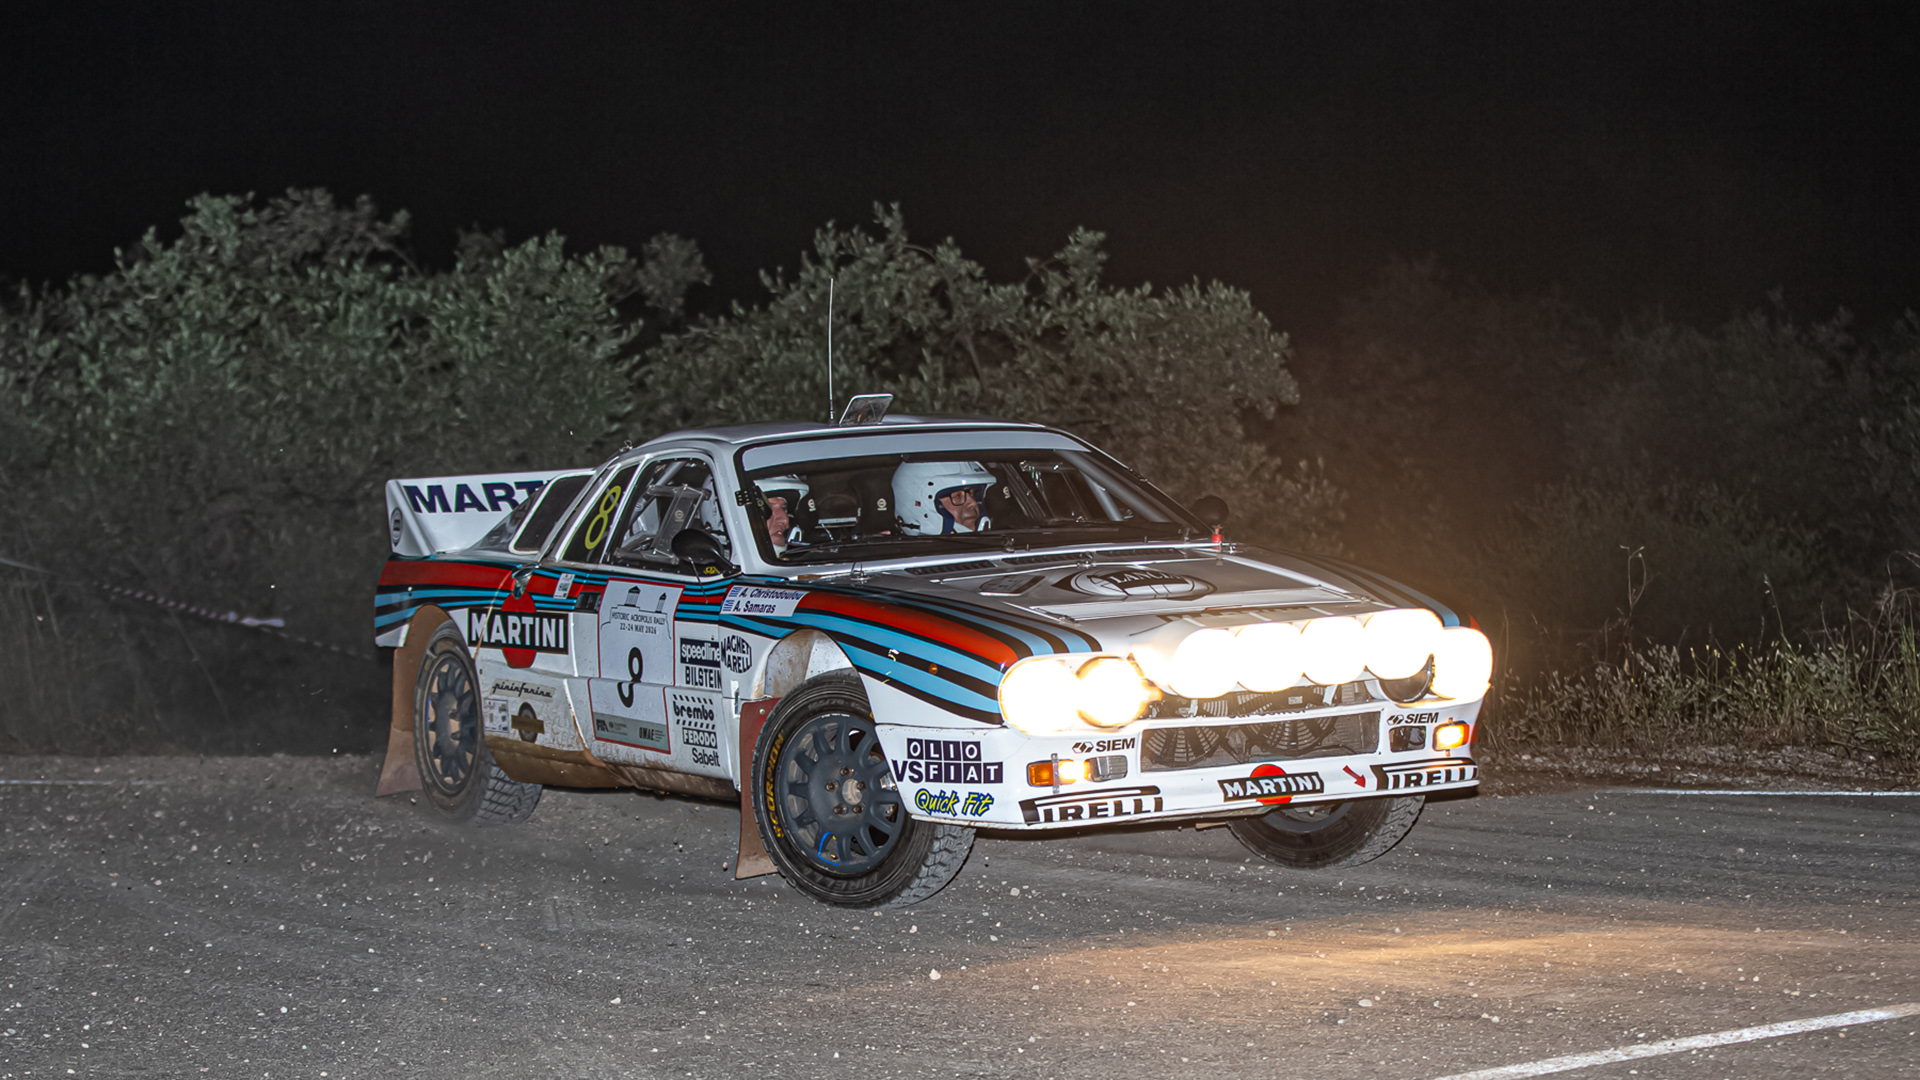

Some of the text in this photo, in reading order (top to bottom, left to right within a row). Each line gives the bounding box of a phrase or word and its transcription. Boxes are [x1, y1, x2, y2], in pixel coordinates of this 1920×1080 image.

[403, 480, 549, 513] MART
[585, 485, 621, 550] 8
[739, 587, 747, 598] A.
[733, 600, 776, 614] A. Samaras
[611, 611, 666, 626] HISTORIC ACROPOLIS RALLY
[472, 612, 565, 650] MARTINI
[681, 642, 721, 662] speedline
[617, 646, 643, 708] 8
[492, 681, 552, 698] pininfarina
[673, 701, 715, 721] brembo
[1404, 712, 1440, 724] SIEM
[683, 728, 717, 748] FERODO
[1095, 737, 1136, 752] SIEM
[692, 747, 721, 768] Sabelt
[909, 741, 978, 759] OLIO
[1369, 757, 1478, 791] PIRELLI
[766, 733, 785, 839] SCORPION
[1223, 774, 1321, 798] MARTINI
[915, 788, 995, 817] Quick Fit
[1018, 785, 1164, 827] PIRELLI
